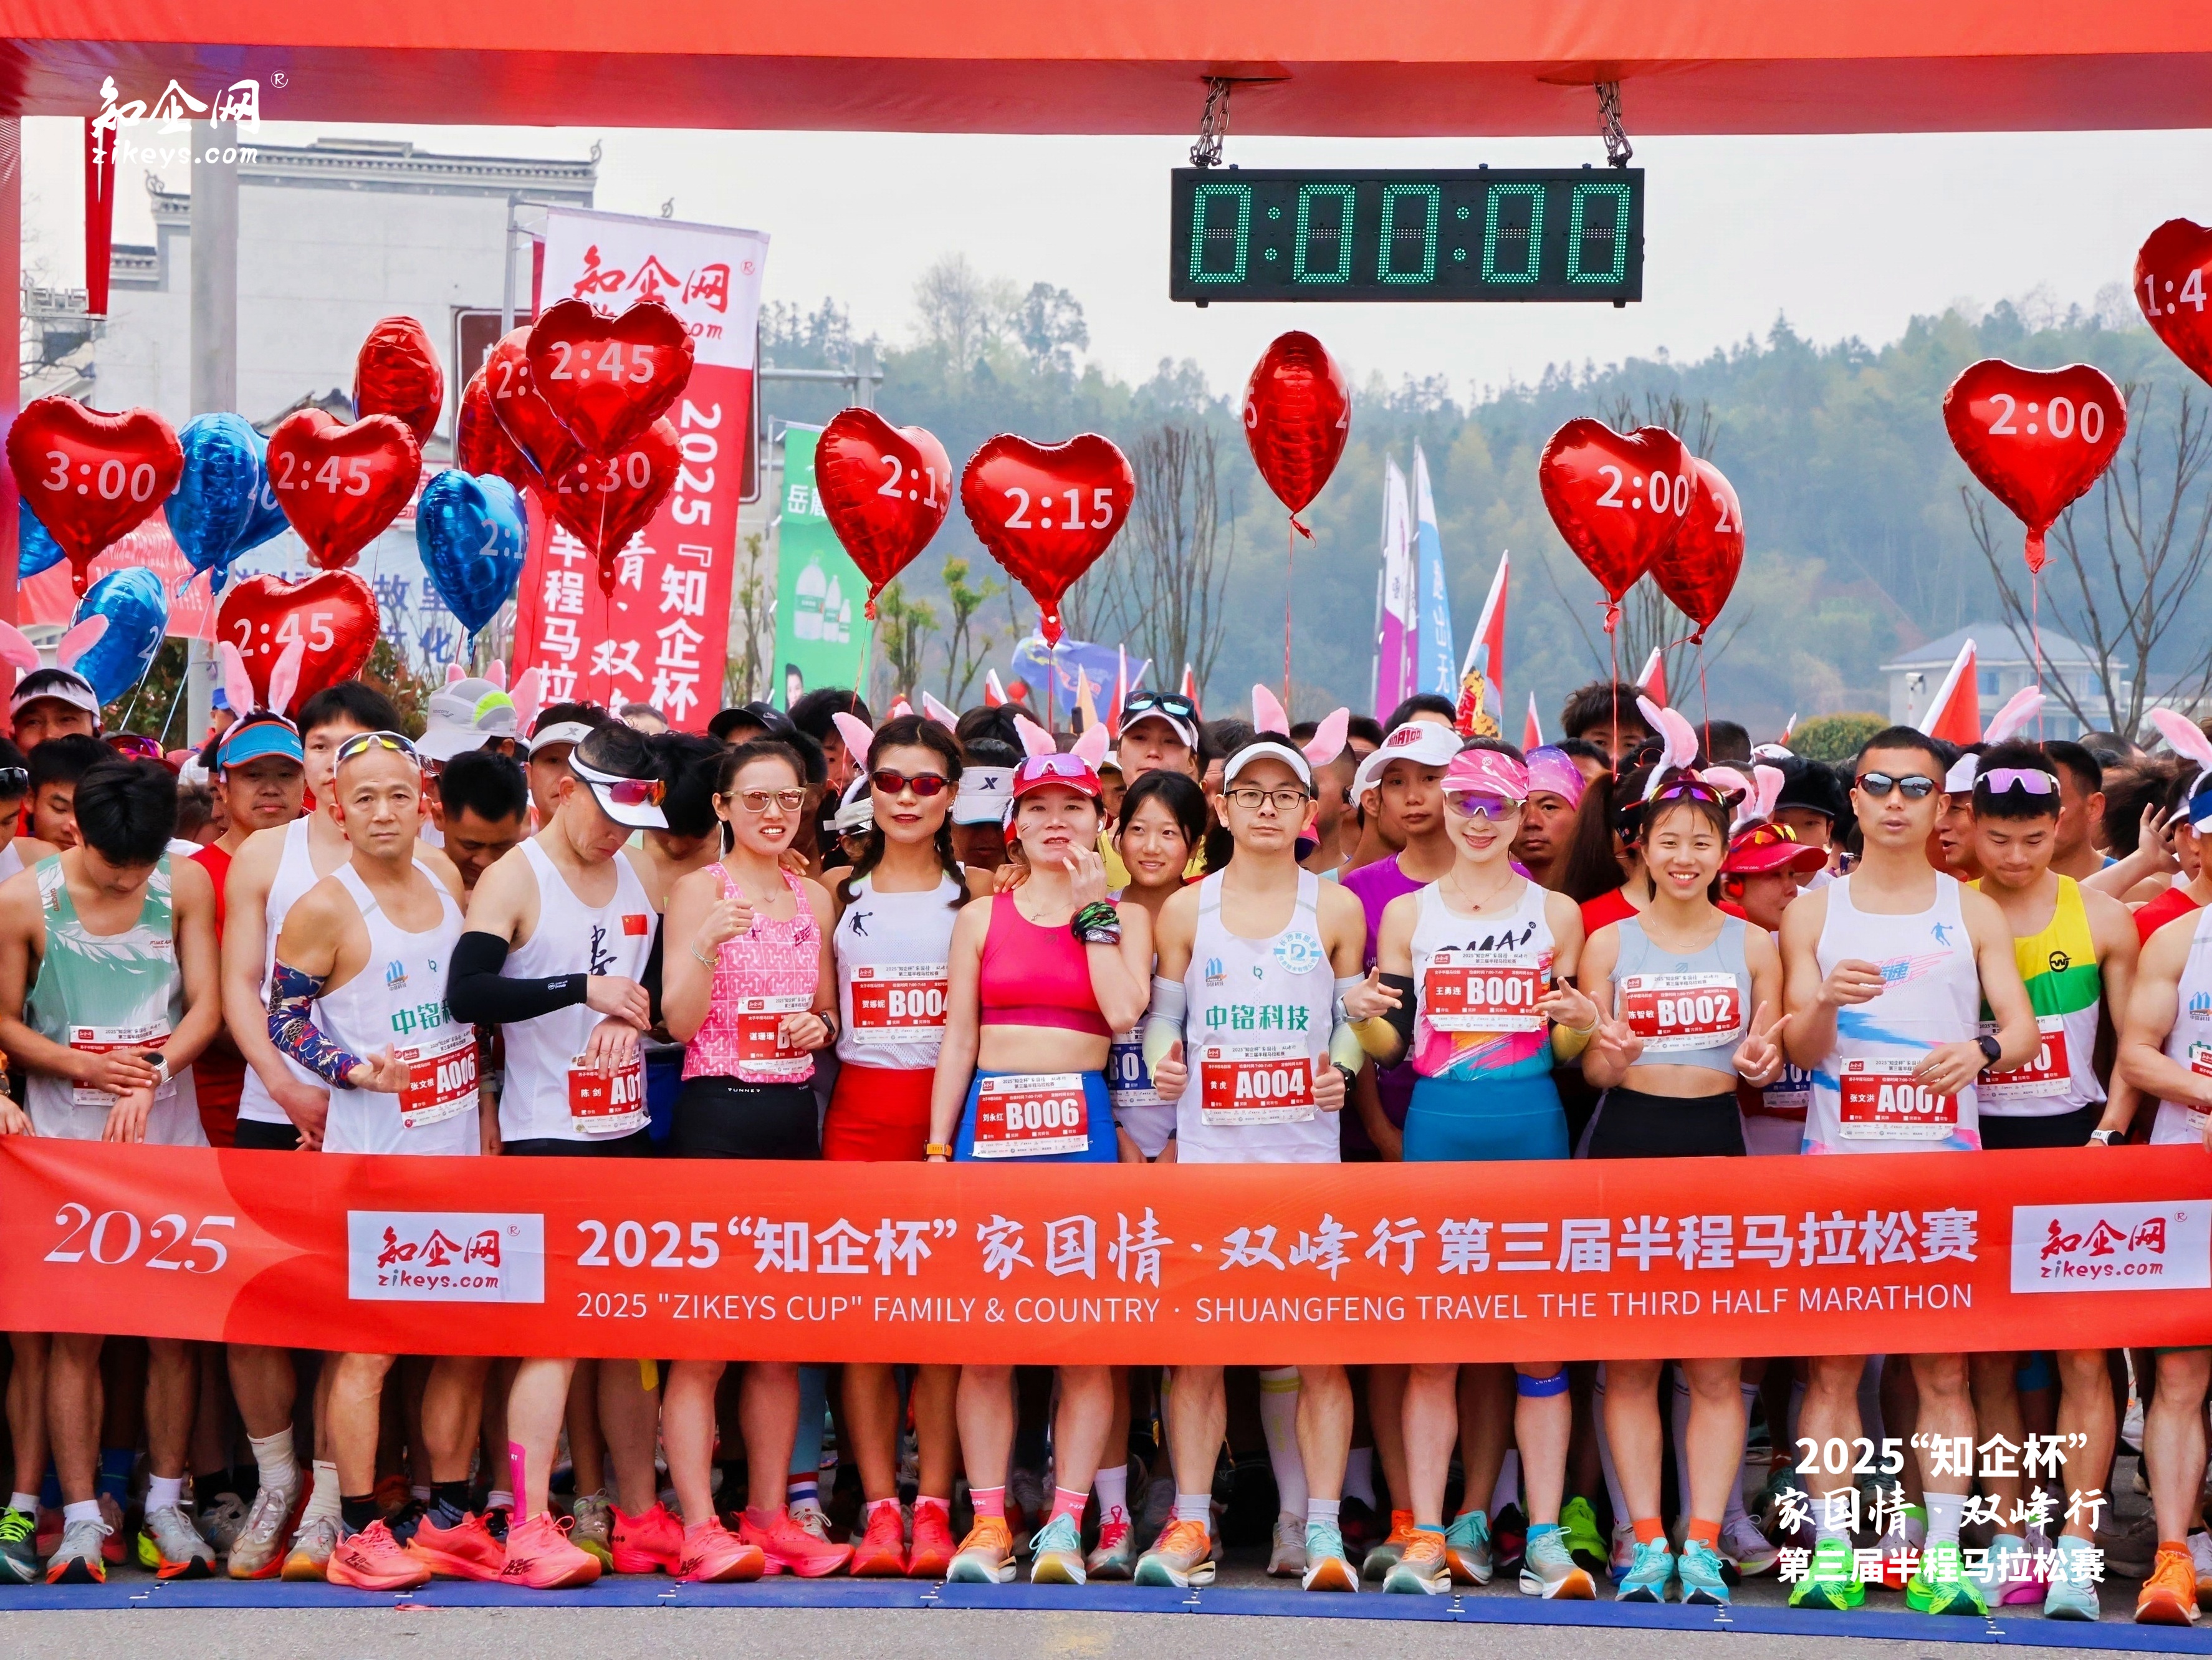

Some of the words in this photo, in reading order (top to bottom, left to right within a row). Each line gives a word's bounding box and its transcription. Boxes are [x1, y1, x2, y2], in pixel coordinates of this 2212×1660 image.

[1189, 184, 1630, 284] 0:00:00
[573, 244, 730, 314] 知企网
[550, 341, 654, 383] 2:45
[1988, 394, 2104, 444] 2:00
[42, 451, 156, 502] 3:00
[278, 451, 371, 496] 2:45
[1596, 464, 1689, 517] 2:00
[1004, 487, 1113, 529] 2:15
[479, 519, 529, 560] 2:1
[234, 613, 334, 657] 2:45
[1436, 987, 1461, 996] 王勇连
[1467, 977, 1533, 1005] B001
[1657, 995, 1731, 1027] B002
[1206, 1004, 1309, 1031] 中铭科技
[1628, 1010, 1654, 1019] 陈智敏
[437, 1053, 475, 1094] A006
[1235, 1068, 1305, 1098] A004
[983, 1113, 1003, 1121] 刘永红
[1006, 1098, 1079, 1130] B006
[1850, 1094, 1875, 1103] 张文洪
[44, 1202, 236, 1275] 2025
[376, 1226, 500, 1270] 知企网
[2040, 1218, 2167, 1260] 知企网
[378, 1270, 499, 1290] zikeys.com
[2041, 1260, 2163, 1280] zikeys.com
[577, 1293, 647, 1318] 2025
[658, 1293, 776, 1320] "ZIKEYS
[787, 1295, 862, 1322] CUP"
[875, 1297, 975, 1323] FAMILY
[985, 1298, 1005, 1323] &
[1015, 1298, 1161, 1323] COUNTRY
[1195, 1296, 1405, 1323] SHUANGFENG
[1417, 1294, 1527, 1320] TRAVEL
[1538, 1292, 1596, 1318] THE
[1607, 1290, 1700, 1316] THIRD
[1712, 1288, 1788, 1314] HALF
[1799, 1282, 1972, 1312] MARATHON
